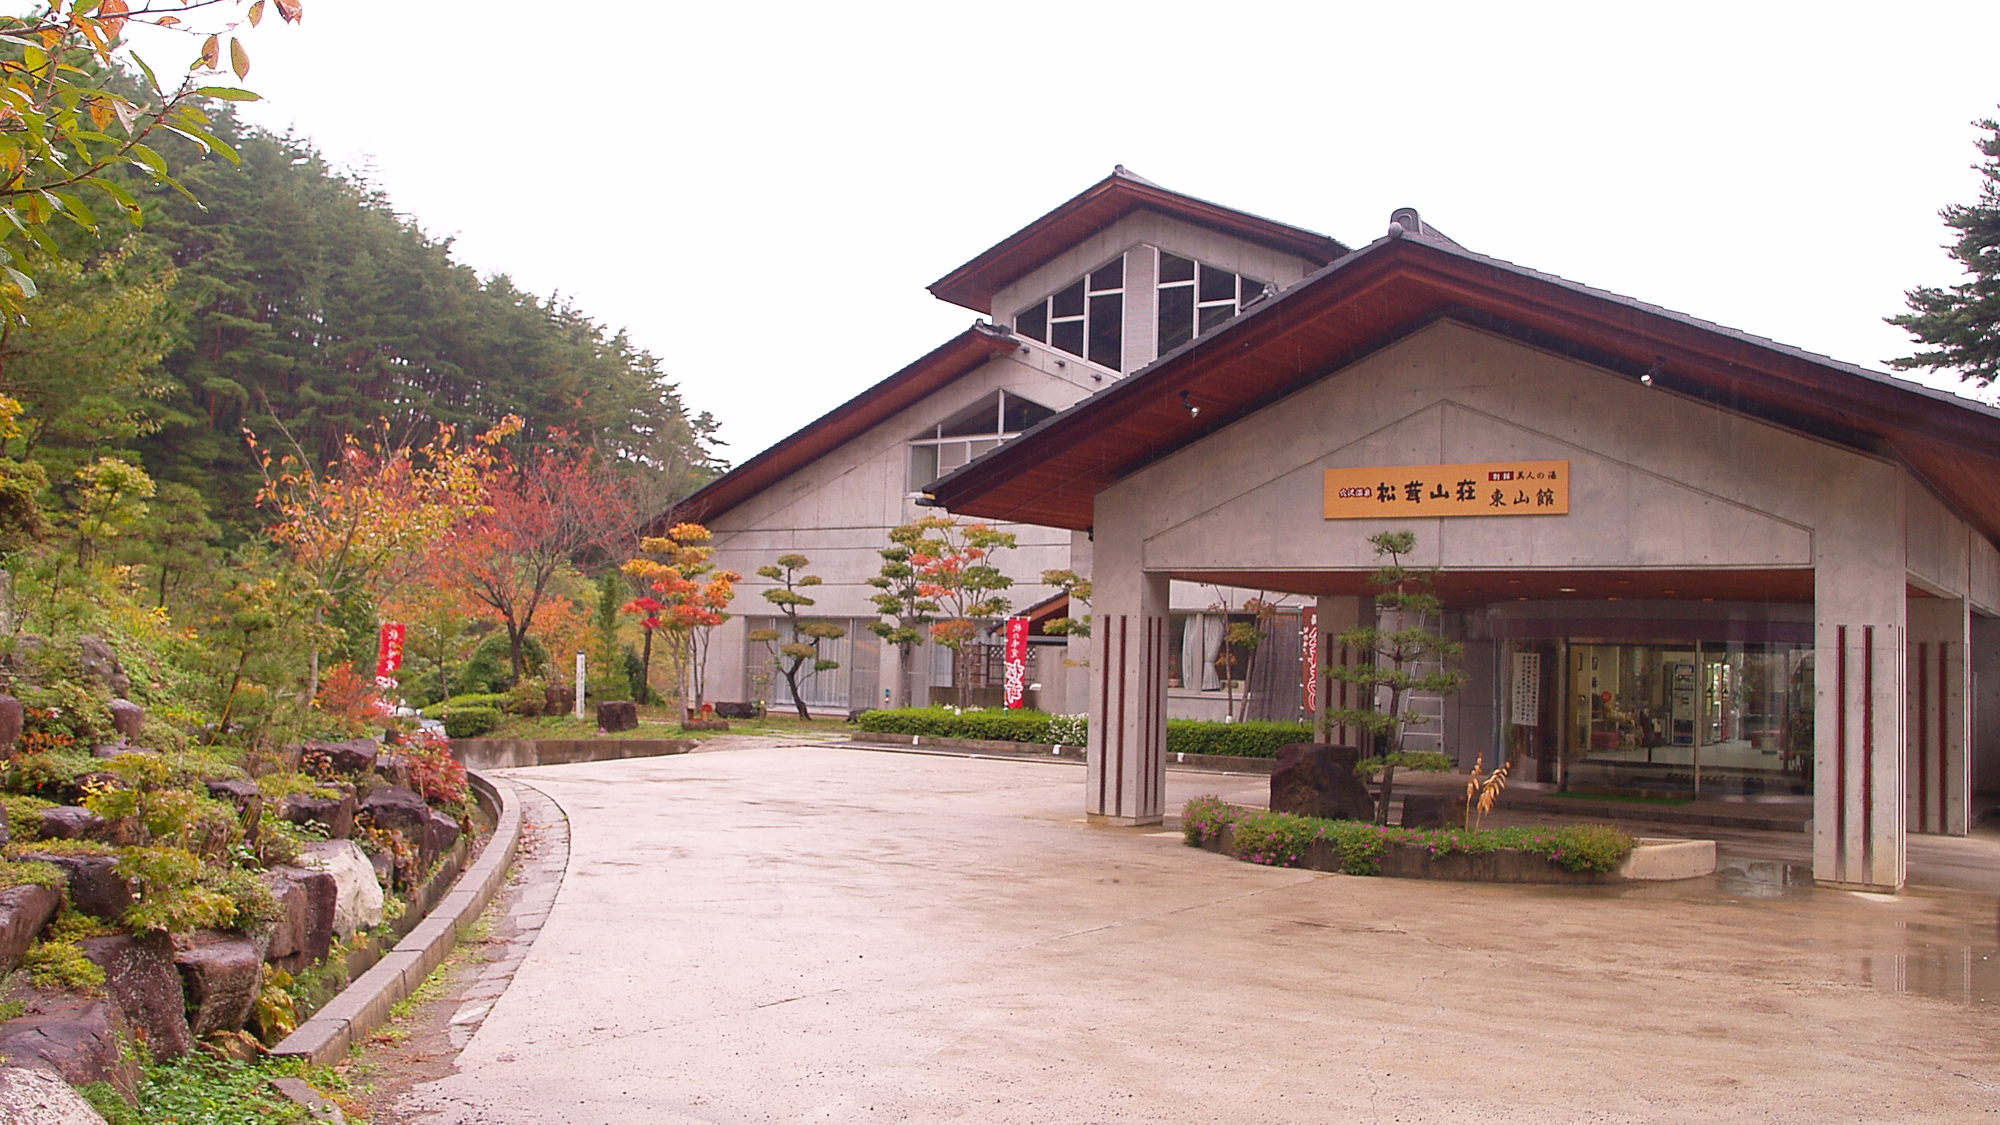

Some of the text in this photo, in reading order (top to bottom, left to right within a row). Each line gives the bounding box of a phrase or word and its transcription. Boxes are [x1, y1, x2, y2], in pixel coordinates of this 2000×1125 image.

[1516, 470, 1557, 480] 美人の湯
[1377, 479, 1476, 505] 松茸山荘
[1489, 488, 1555, 507] 東山館
